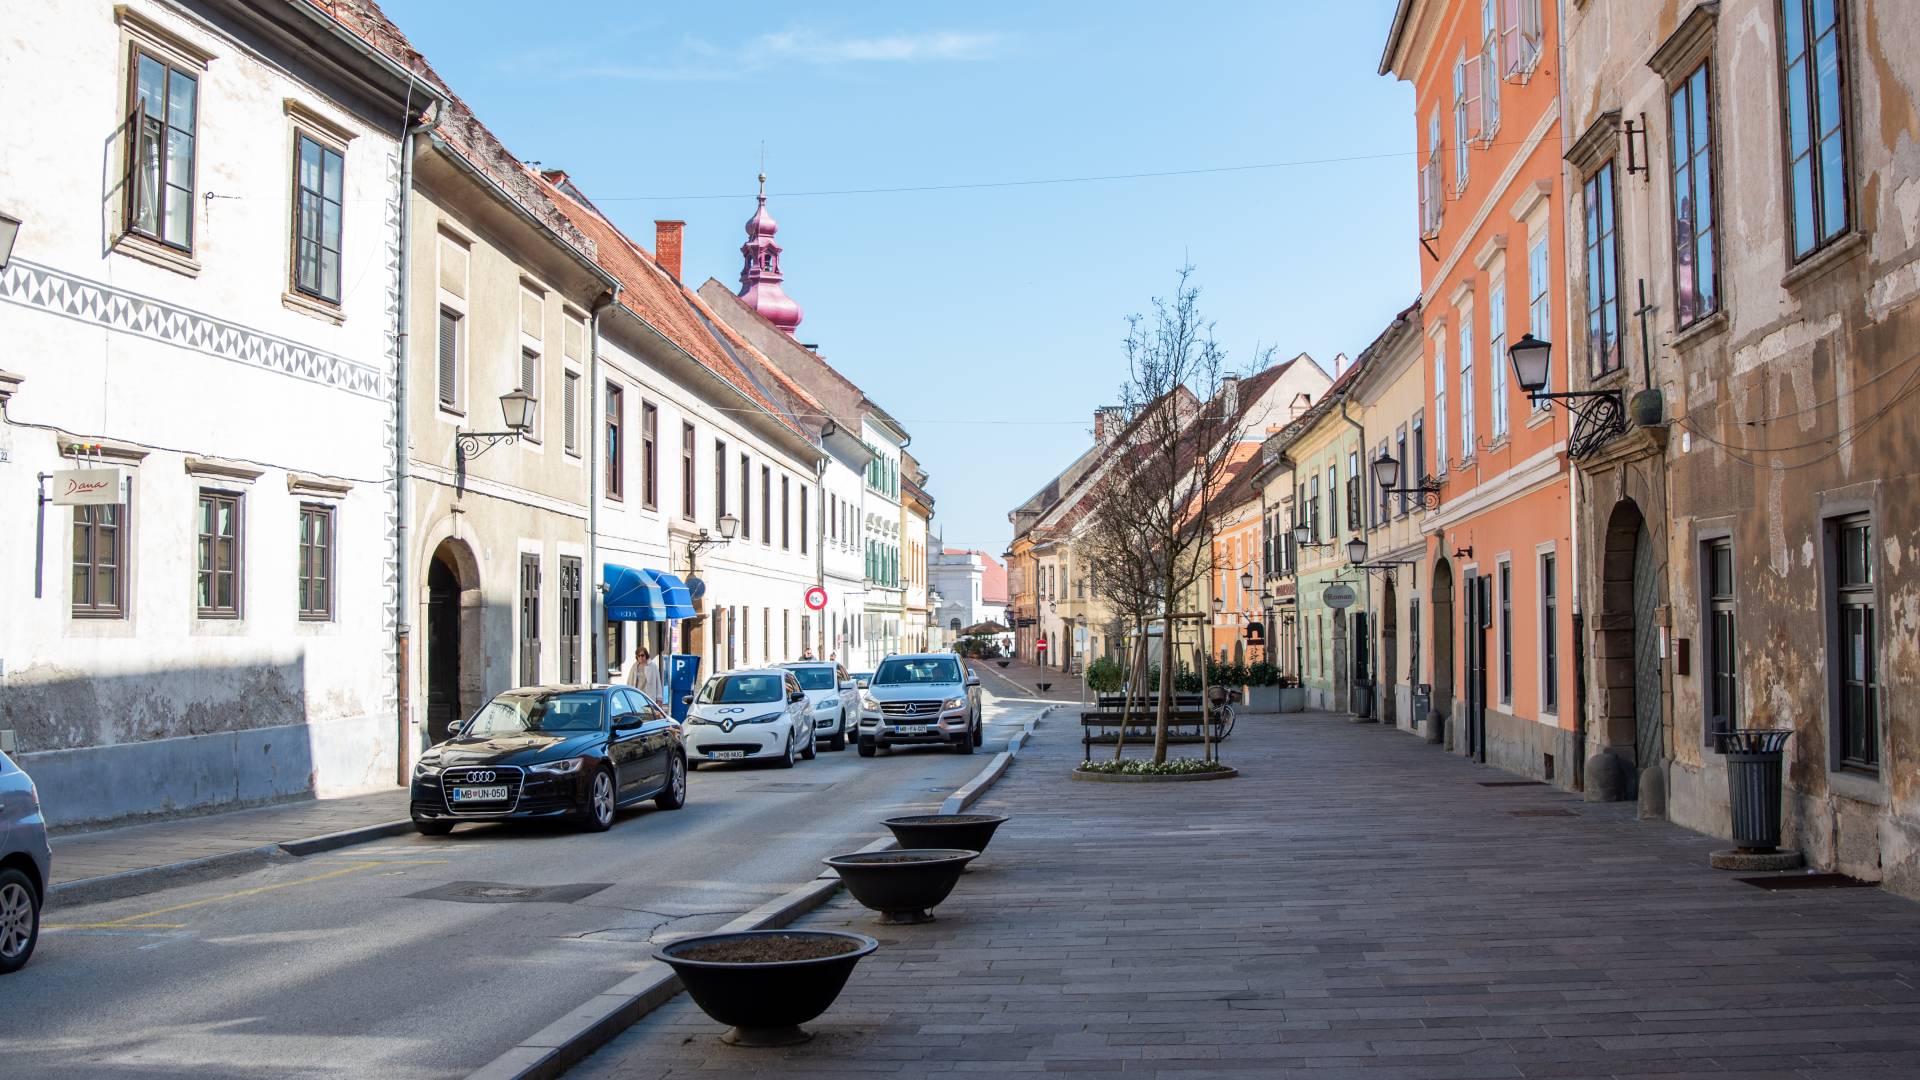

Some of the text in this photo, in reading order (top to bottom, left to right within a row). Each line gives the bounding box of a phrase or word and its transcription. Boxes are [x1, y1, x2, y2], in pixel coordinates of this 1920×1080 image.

[65, 479, 108, 496] Dana
[676, 660, 685, 671] P
[460, 788, 507, 799] MB UN-050
